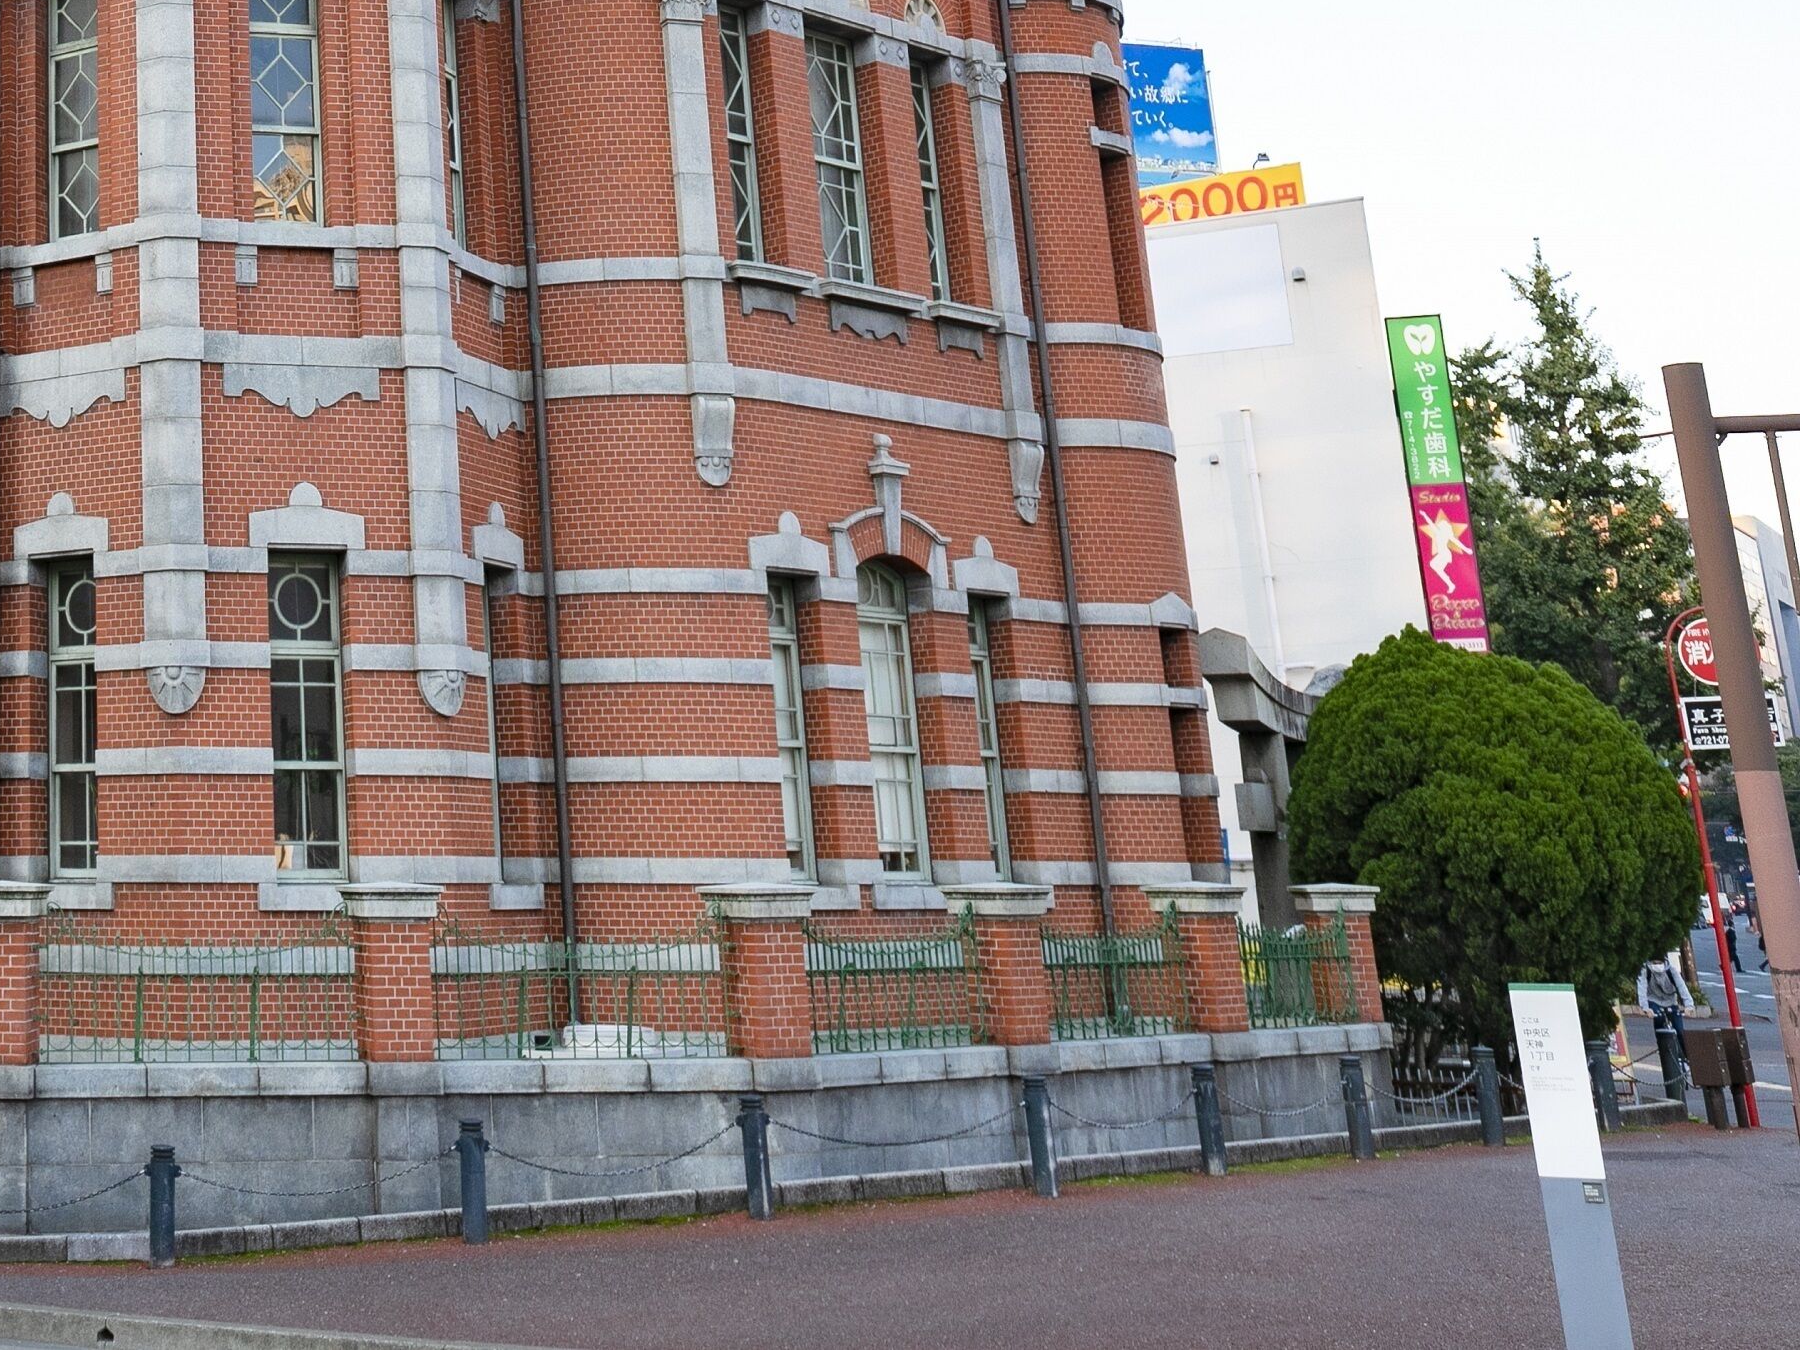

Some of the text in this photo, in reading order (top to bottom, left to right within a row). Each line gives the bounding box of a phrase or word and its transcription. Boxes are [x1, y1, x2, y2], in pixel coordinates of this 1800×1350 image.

[1130, 85, 1188, 104] い故郷に
[1132, 110, 1174, 128] ていく。
[1414, 361, 1451, 479] やすだ歯科
[1419, 490, 1461, 504] Studio
[1687, 629, 1701, 637] FIRE
[1523, 1028, 1550, 1037] 中央区
[1526, 1040, 1544, 1049] 天神
